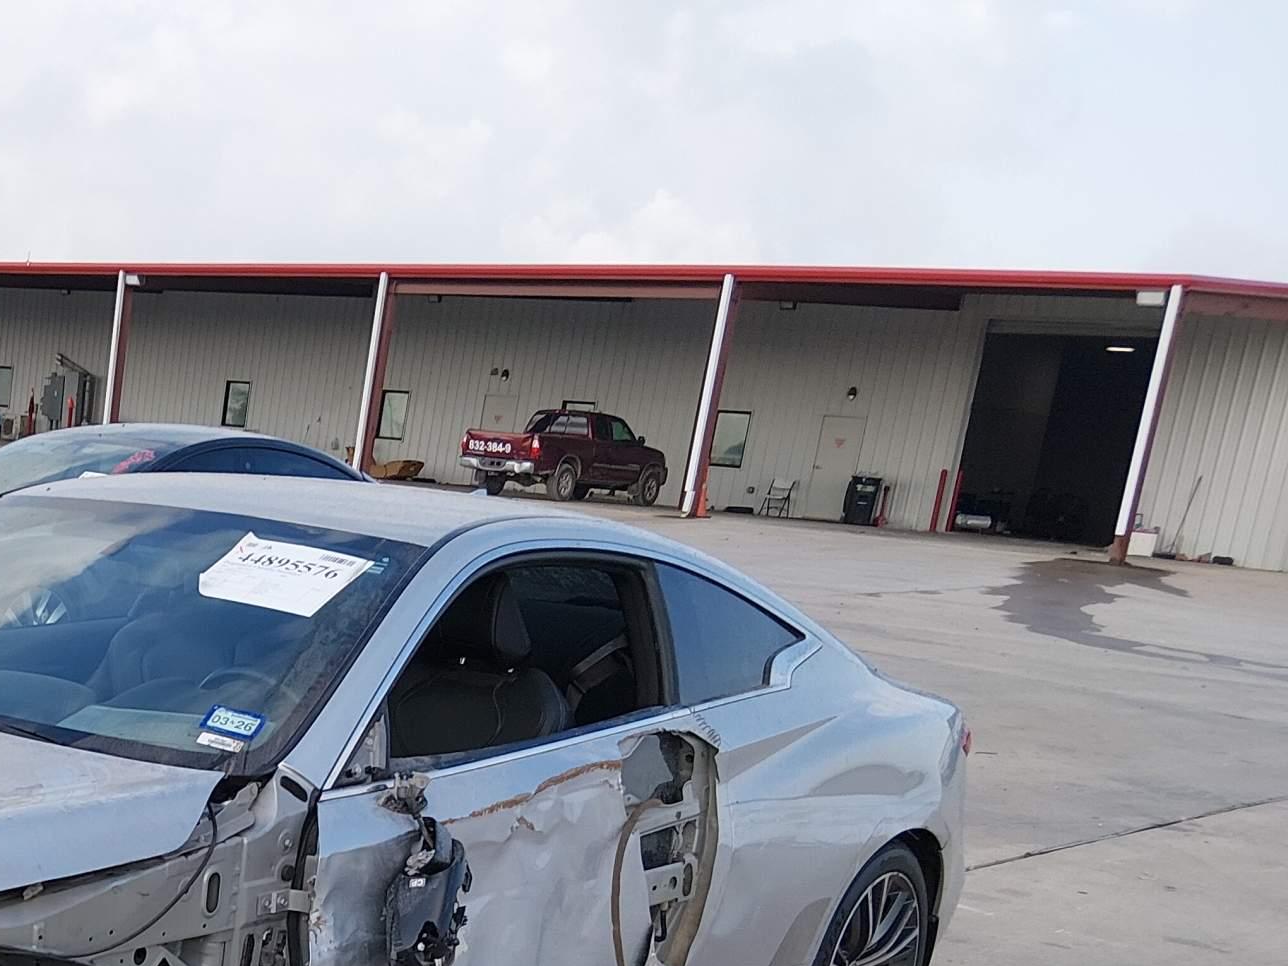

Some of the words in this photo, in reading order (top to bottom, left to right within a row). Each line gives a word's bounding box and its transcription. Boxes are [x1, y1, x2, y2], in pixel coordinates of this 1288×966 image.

[237, 552, 339, 579] 44895576
[211, 714, 230, 726] 03
[234, 720, 256, 732] 26
